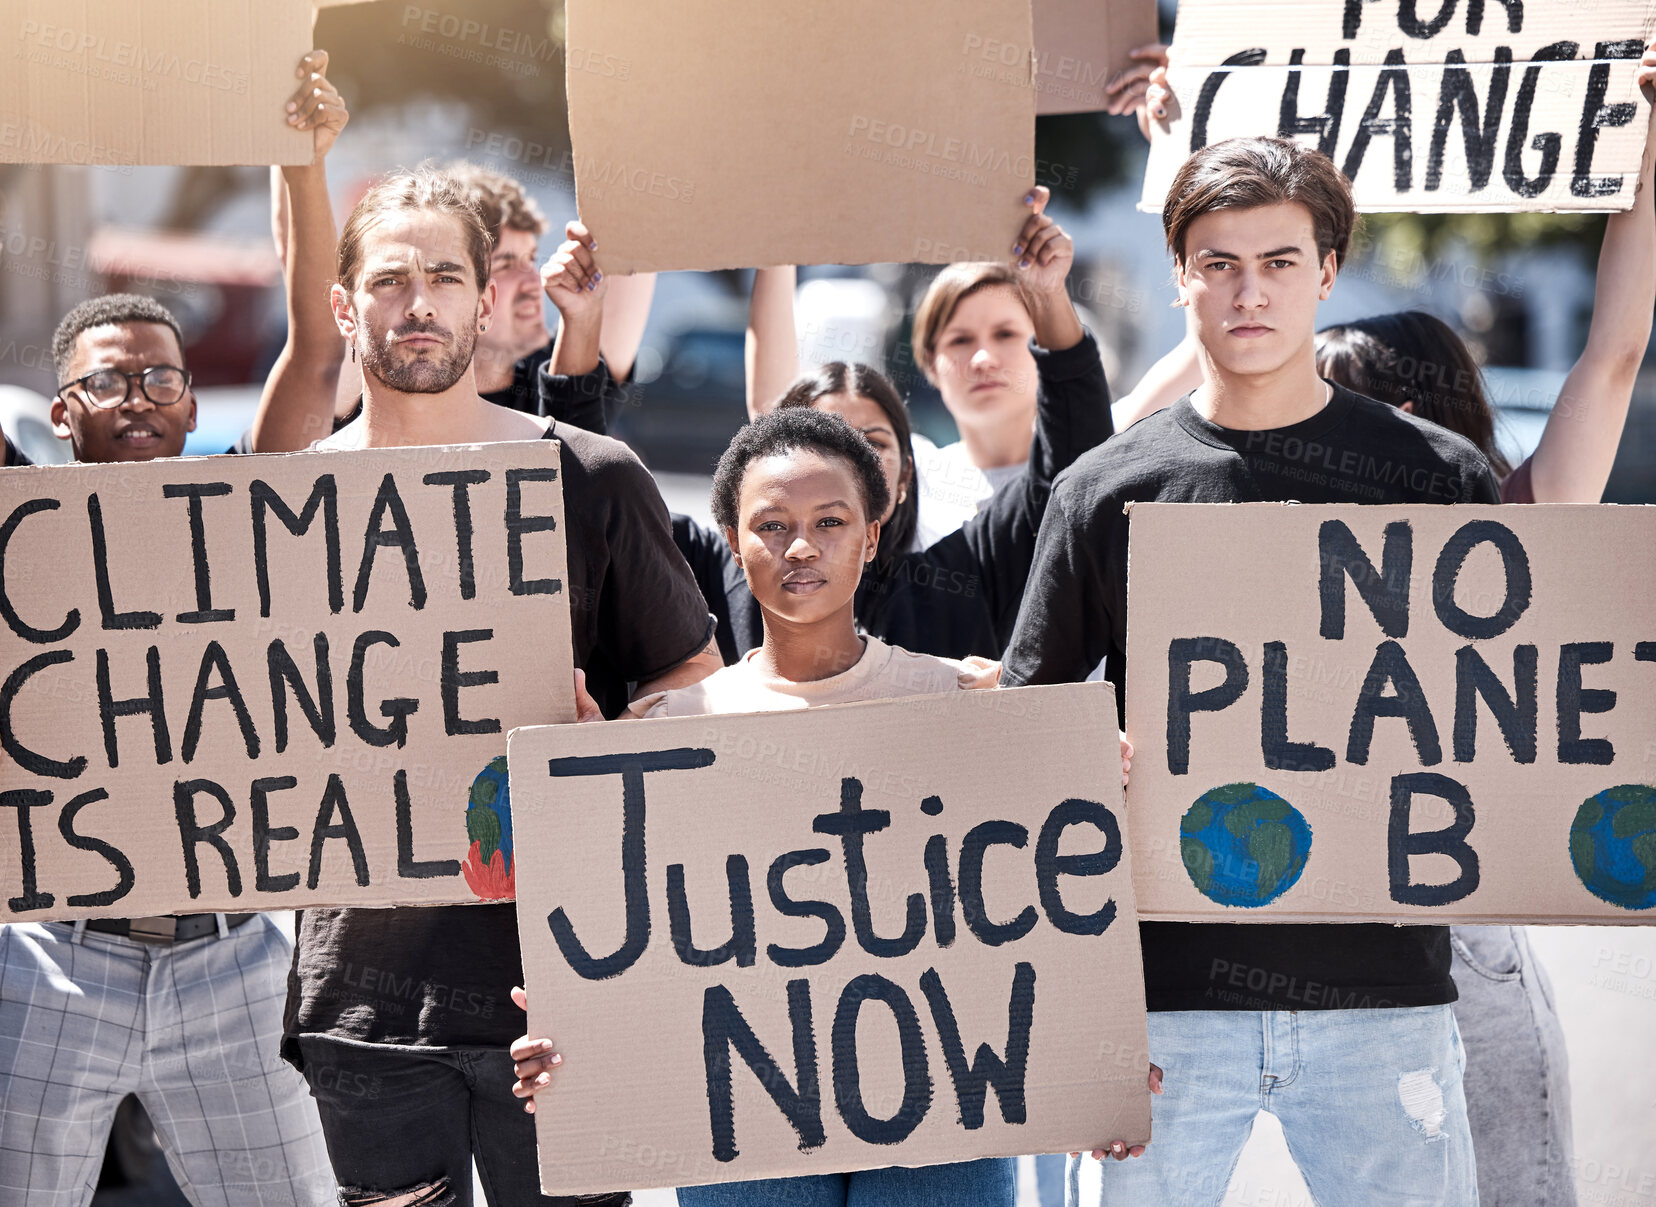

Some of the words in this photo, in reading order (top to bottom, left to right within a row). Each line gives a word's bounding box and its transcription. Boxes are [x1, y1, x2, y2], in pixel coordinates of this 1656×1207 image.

[1190, 39, 1645, 199] CHANGE
[0, 468, 562, 643] CLIMATE
[1318, 519, 1532, 640] NO
[0, 629, 501, 779] CHANGE
[1167, 636, 1656, 776] PLANE
[0, 787, 135, 912] IS
[173, 769, 462, 899] REAL
[547, 747, 1123, 981] Justice
[1388, 772, 1480, 907] B
[702, 962, 1036, 1162] NOW
